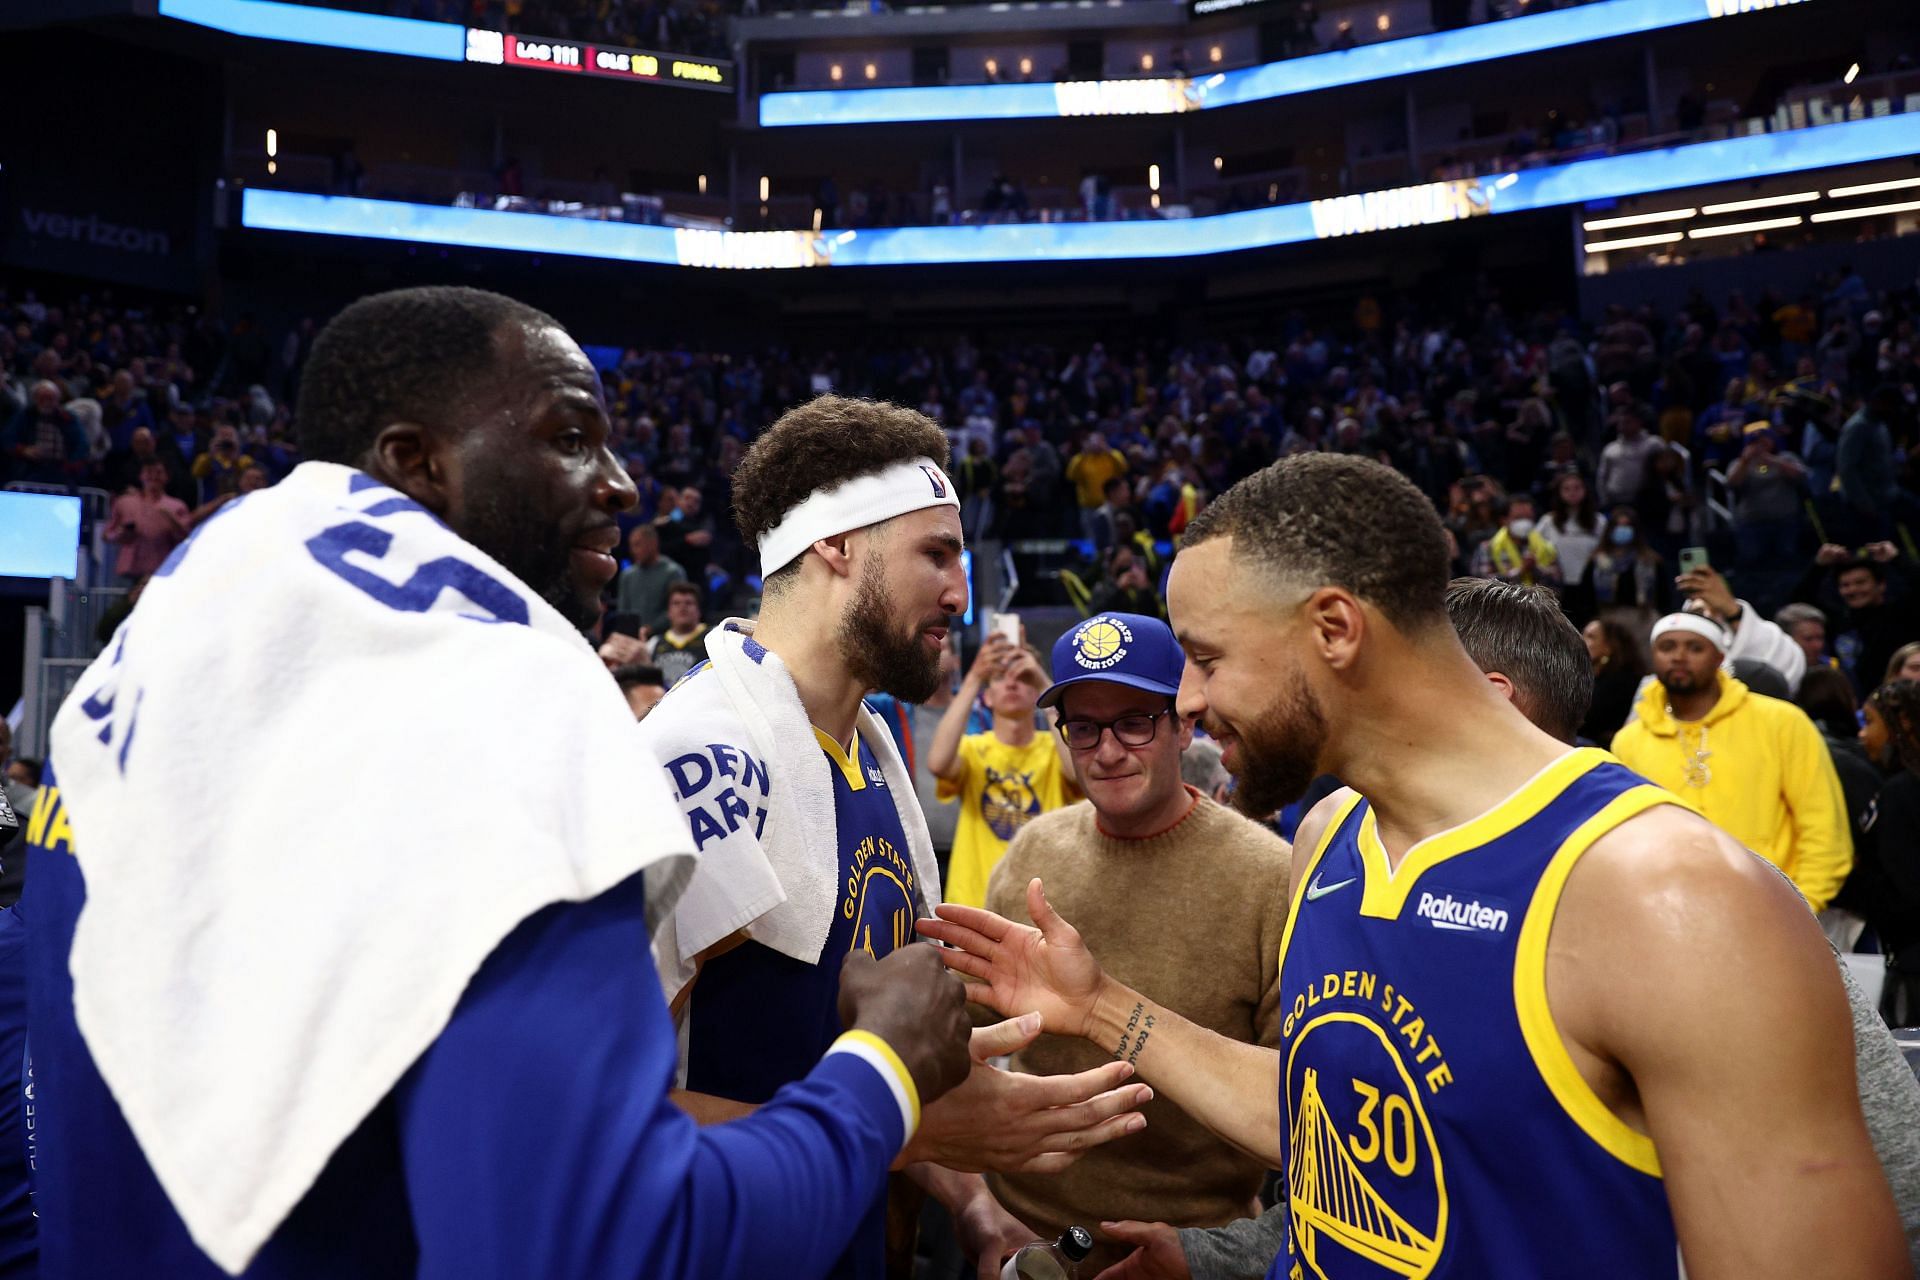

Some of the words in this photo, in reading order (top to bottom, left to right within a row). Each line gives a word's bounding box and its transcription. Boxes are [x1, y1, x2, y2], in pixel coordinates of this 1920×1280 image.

[21, 208, 170, 255] verizon
[1072, 616, 1107, 646] GOLDEN
[1109, 618, 1133, 643] STATE
[1074, 648, 1127, 669] WARRIORS
[664, 743, 770, 797] DEN
[843, 835, 875, 920] GOLDEN
[878, 836, 914, 901] STATE
[1416, 892, 1509, 933] Rakuten
[1282, 970, 1377, 1038] GOLDEN
[1381, 984, 1454, 1094] STATE
[1348, 1077, 1417, 1178] 30
